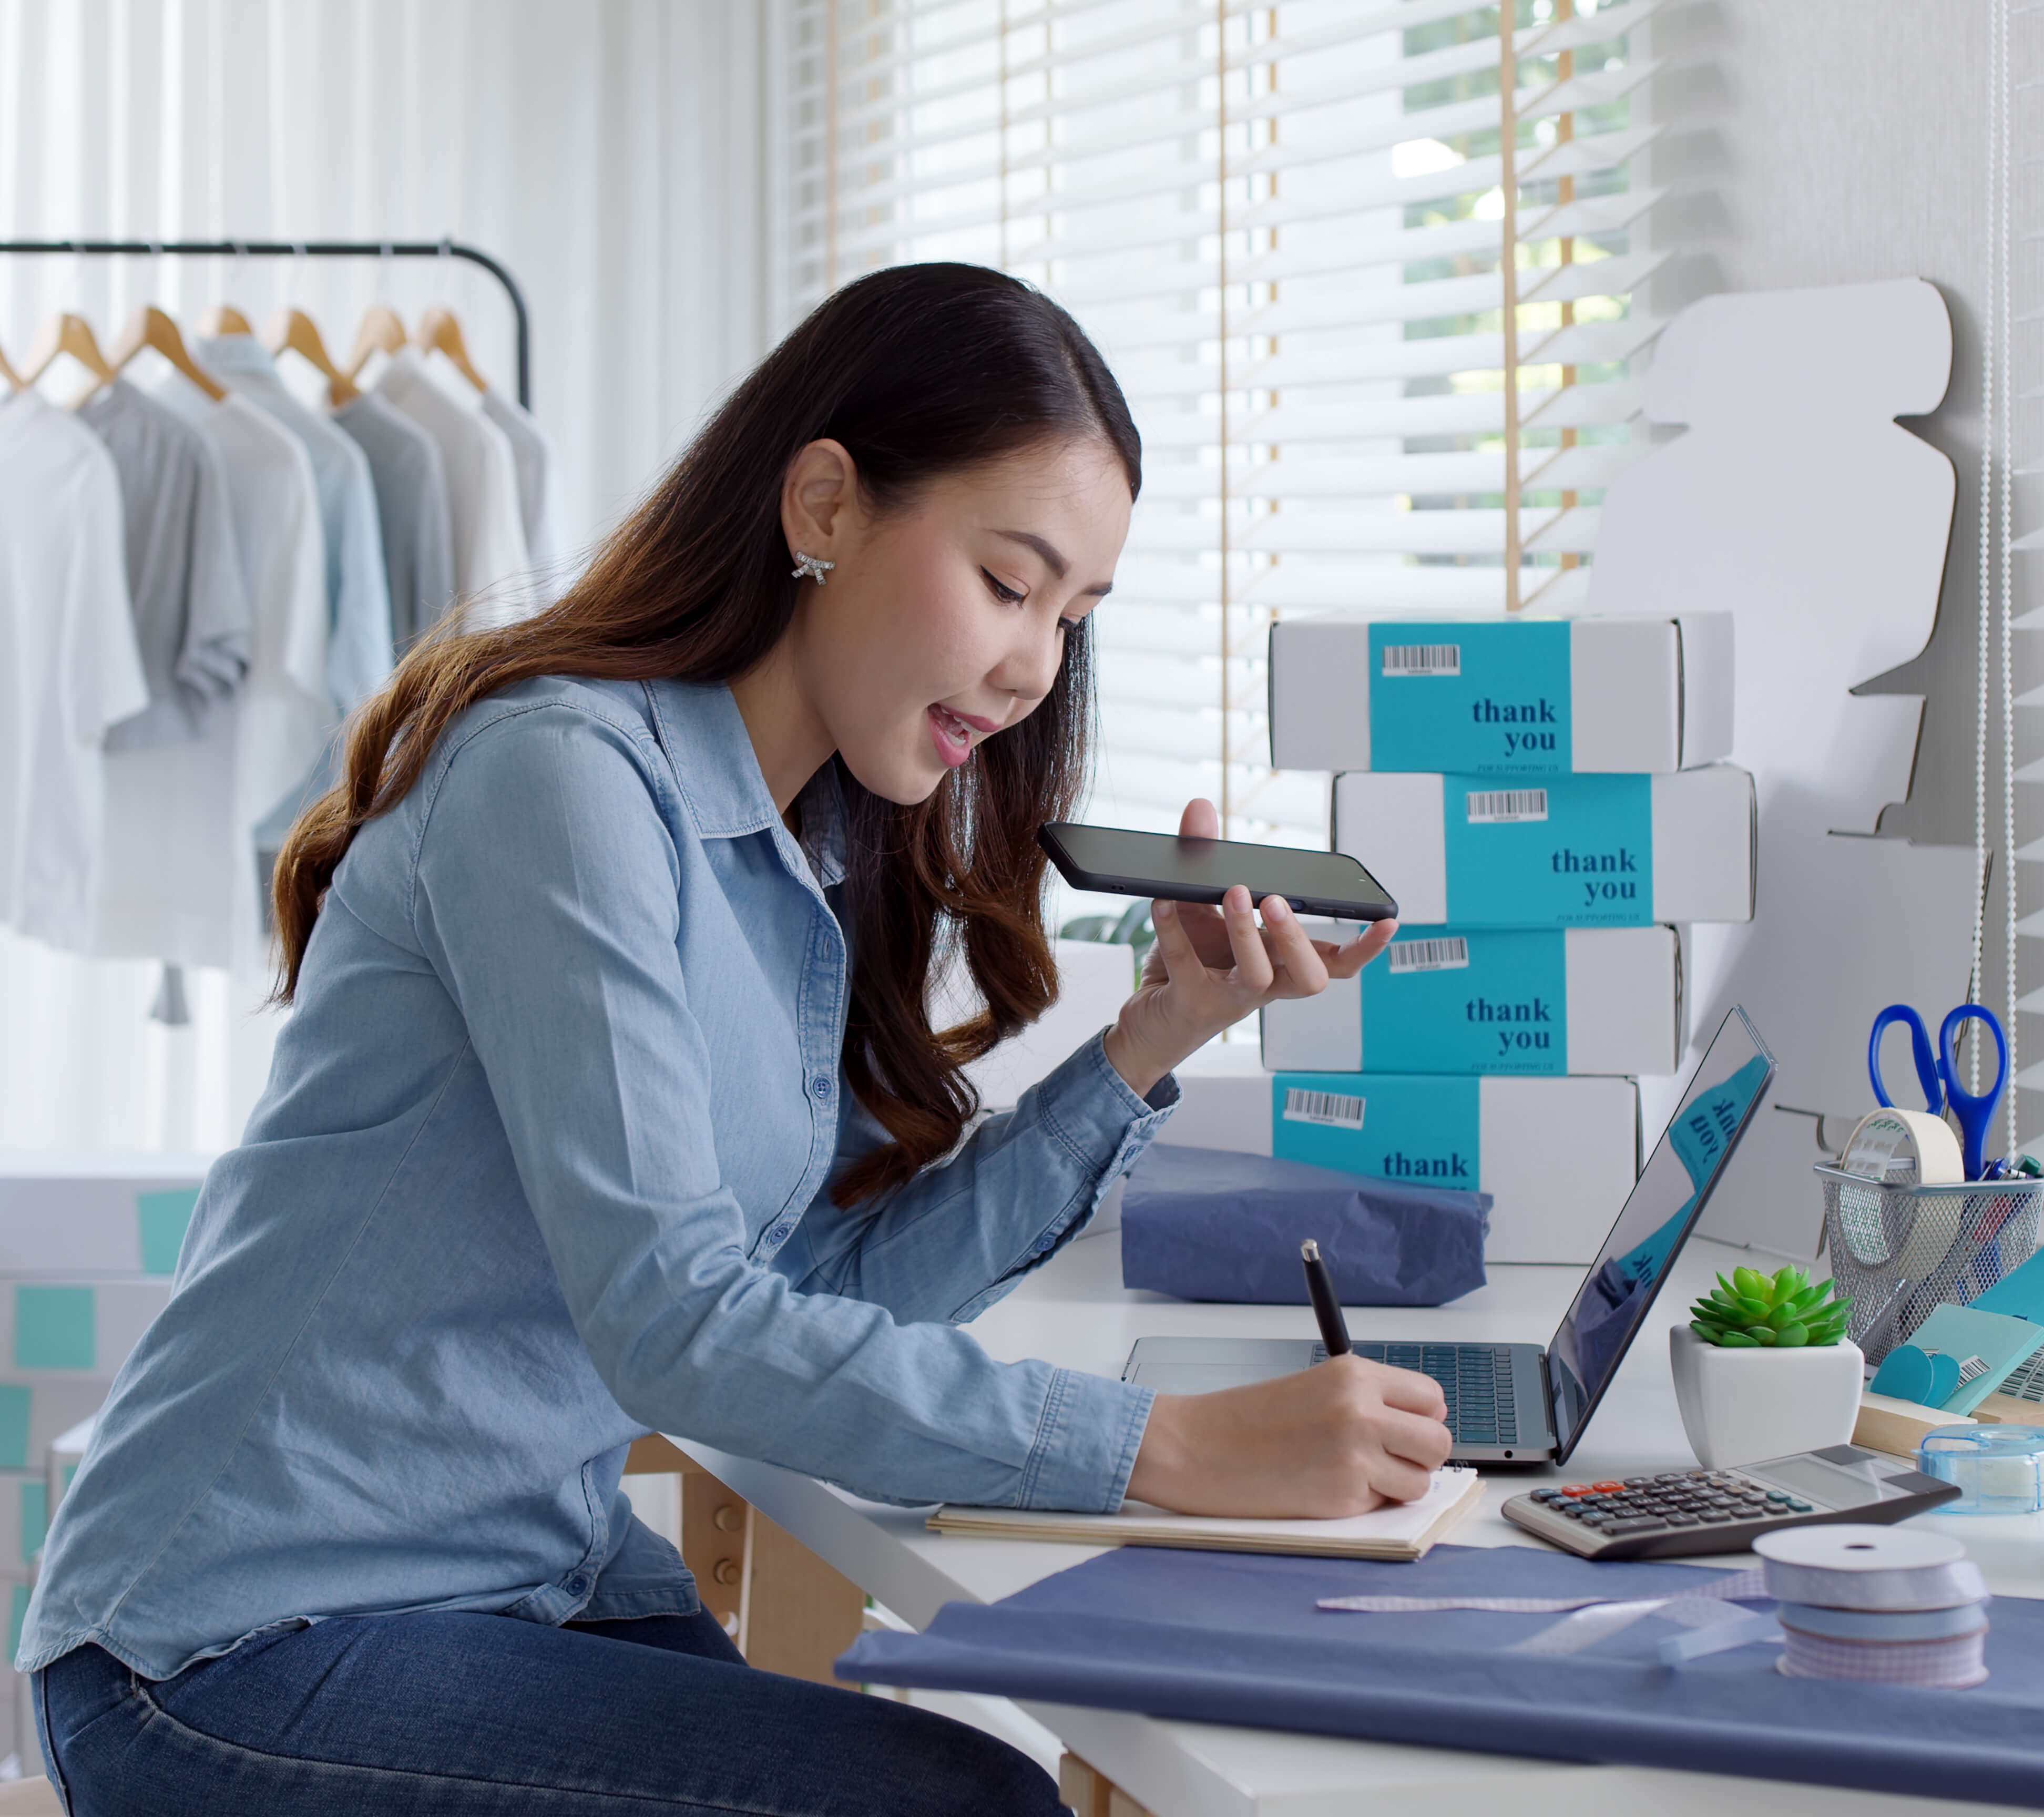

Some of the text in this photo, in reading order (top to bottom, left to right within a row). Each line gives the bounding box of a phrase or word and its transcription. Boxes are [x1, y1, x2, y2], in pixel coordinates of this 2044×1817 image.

[1473, 698, 1556, 723] thank
[1505, 732, 1556, 757] you
[1552, 848, 1636, 873] thank
[1585, 882, 1636, 906] you
[1466, 998, 1550, 1022] thank
[1498, 1032, 1550, 1056] you
[1383, 1152, 1467, 1177] thank
